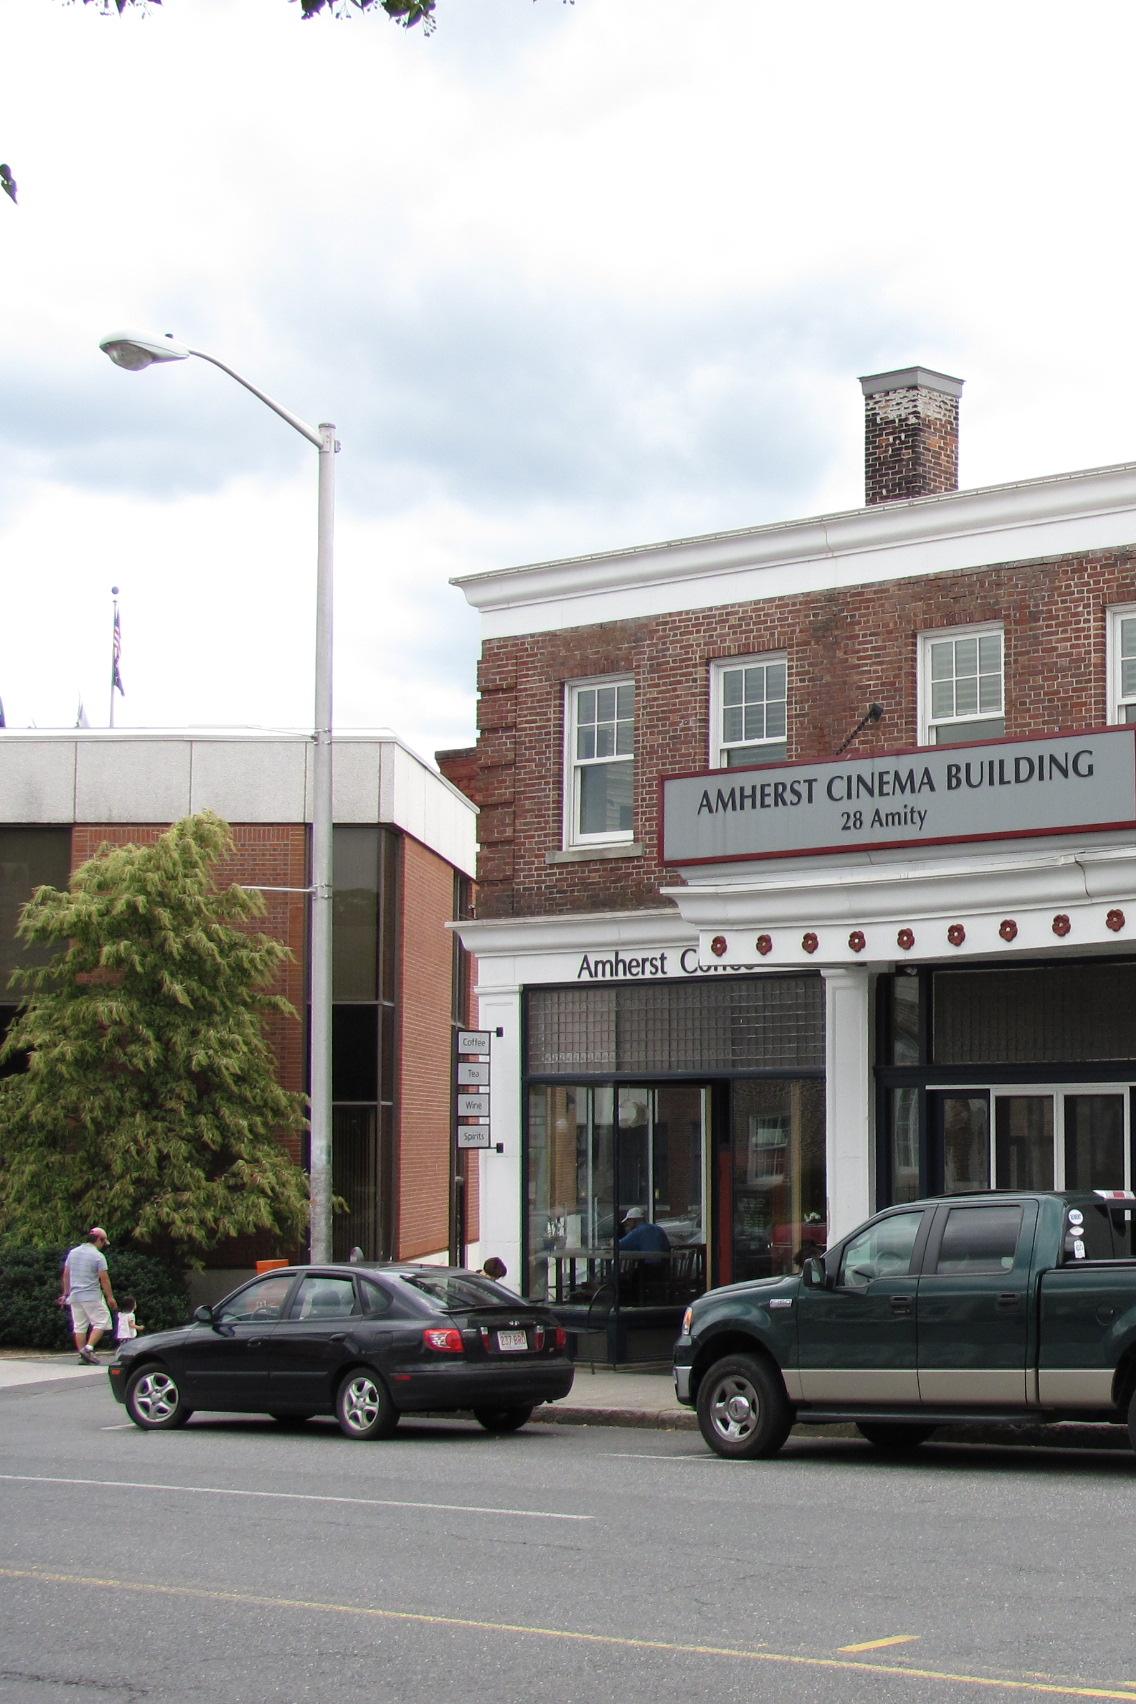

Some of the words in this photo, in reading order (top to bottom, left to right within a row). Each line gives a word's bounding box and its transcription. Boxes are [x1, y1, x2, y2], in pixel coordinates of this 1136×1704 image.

[697, 778, 818, 815] AMHERST
[827, 766, 936, 802] CINEMA
[946, 749, 1094, 791] BUILDING
[841, 811, 863, 831] 28
[871, 804, 928, 831] Amity
[577, 951, 668, 979] Amherst
[463, 1038, 486, 1047] Coffee
[468, 1069, 480, 1078] Tea
[465, 1101, 482, 1110] Wine
[464, 1132, 485, 1141] Spirits
